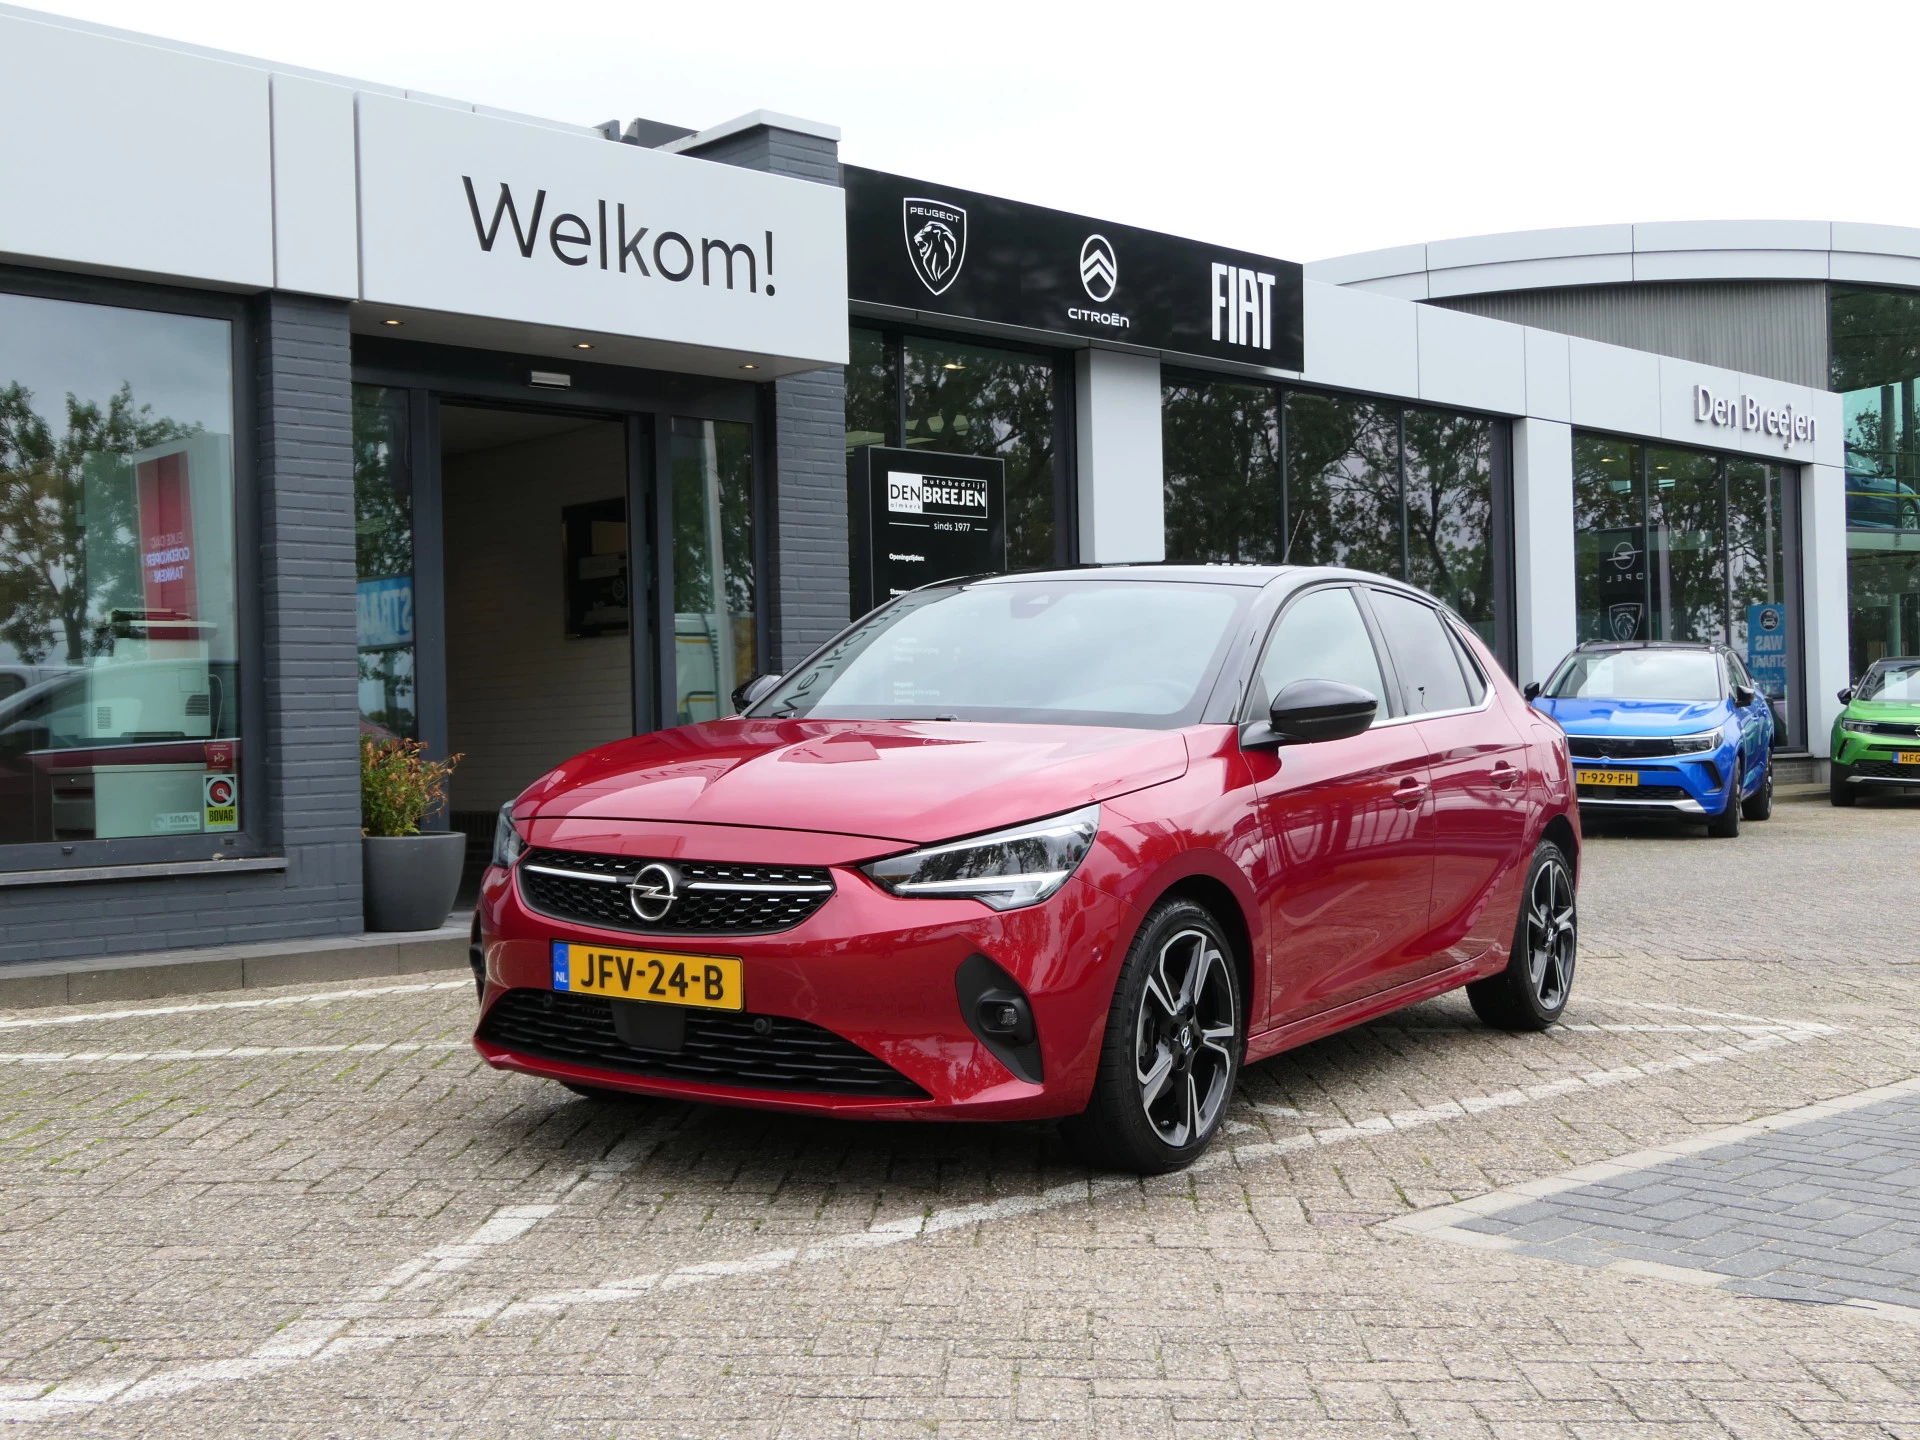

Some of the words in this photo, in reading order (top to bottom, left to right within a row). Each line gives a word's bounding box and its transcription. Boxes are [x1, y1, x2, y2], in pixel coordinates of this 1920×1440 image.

[910, 207, 960, 223] PEUGEOT
[461, 175, 776, 297] Welkom!
[1211, 262, 1276, 350] FIAT
[1067, 307, 1130, 328] CITROËN
[1693, 384, 1740, 428] Den
[1741, 393, 1818, 449] Breejen
[923, 479, 985, 489] autobedrijf
[890, 484, 921, 502] DEN
[923, 486, 986, 508] BREEJEN
[933, 521, 953, 531] sinds
[954, 522, 971, 532] 1977
[1580, 772, 1633, 784] T-929-FH
[208, 809, 234, 822] BOVAG
[555, 971, 569, 983] NL
[580, 953, 724, 1001] JFV-24-B
